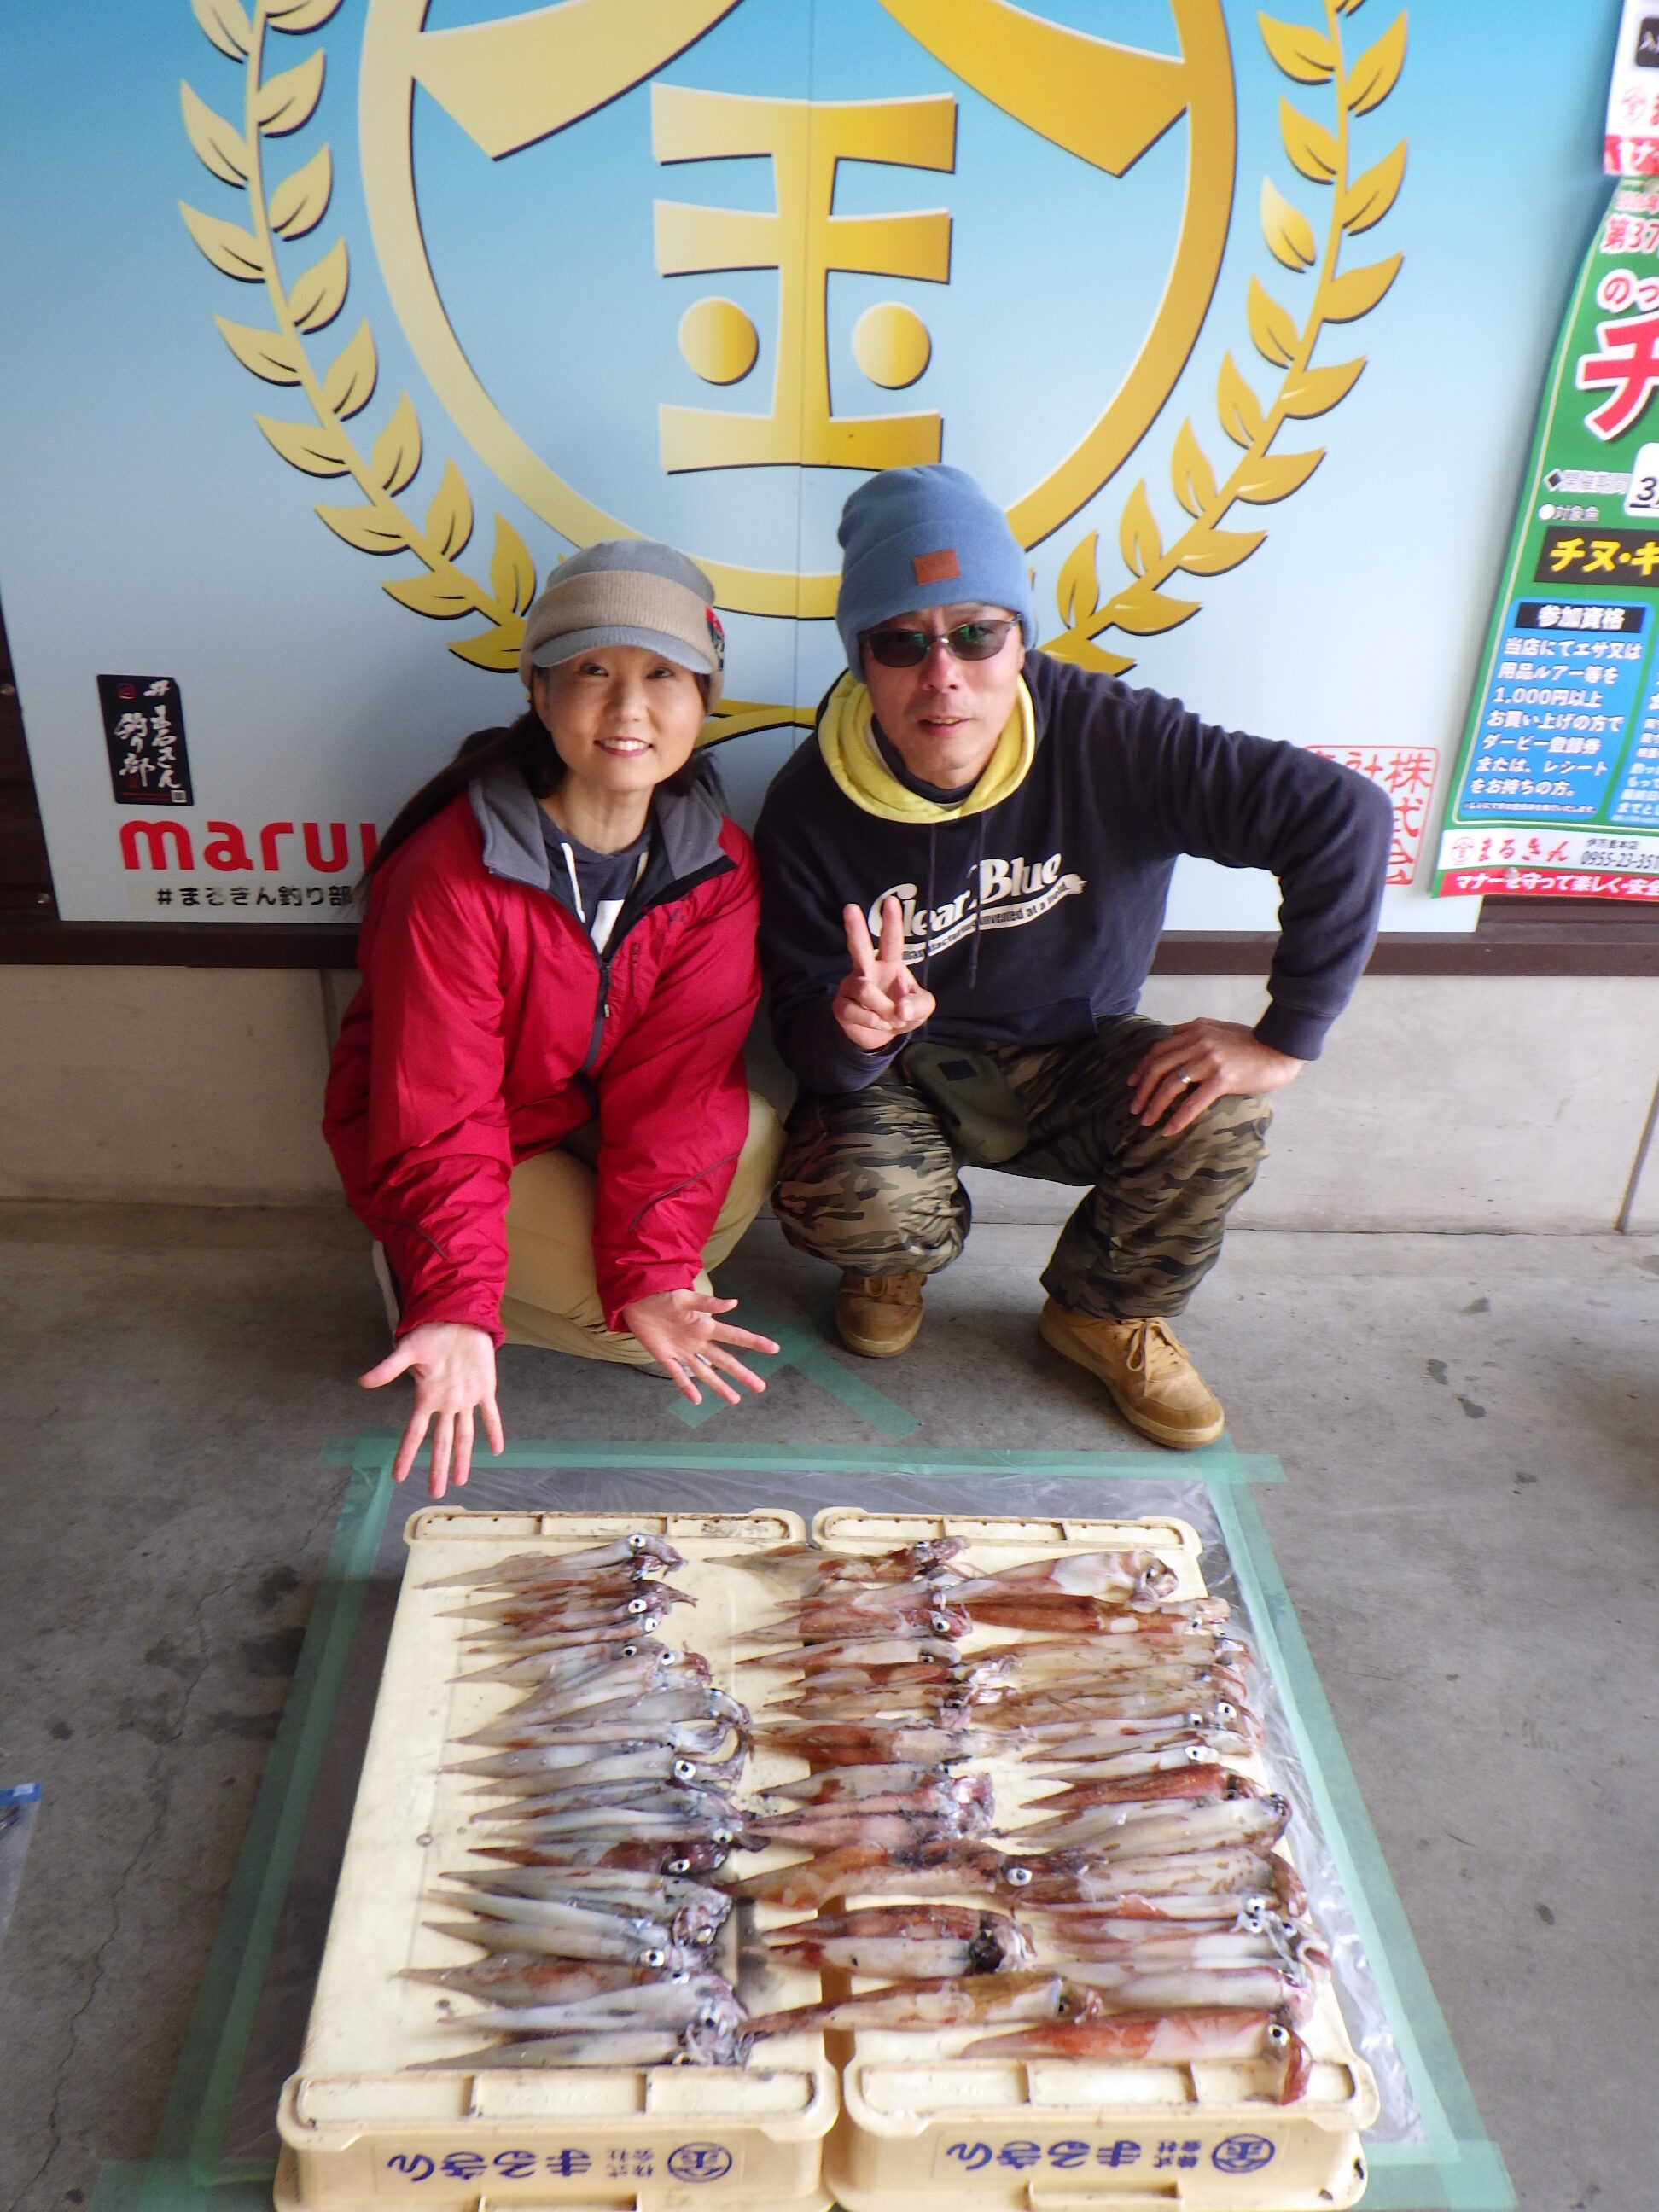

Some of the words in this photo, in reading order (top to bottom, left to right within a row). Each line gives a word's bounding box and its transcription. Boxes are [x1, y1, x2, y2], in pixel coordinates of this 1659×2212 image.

[1538, 604, 1625, 630] 参加資格
[1504, 637, 1642, 660] 当店にてエサ又は
[1498, 661, 1618, 684] 用品ルアー等を
[1470, 777, 1575, 797] をお持ちの方。
[1478, 837, 1569, 863] まるきん
